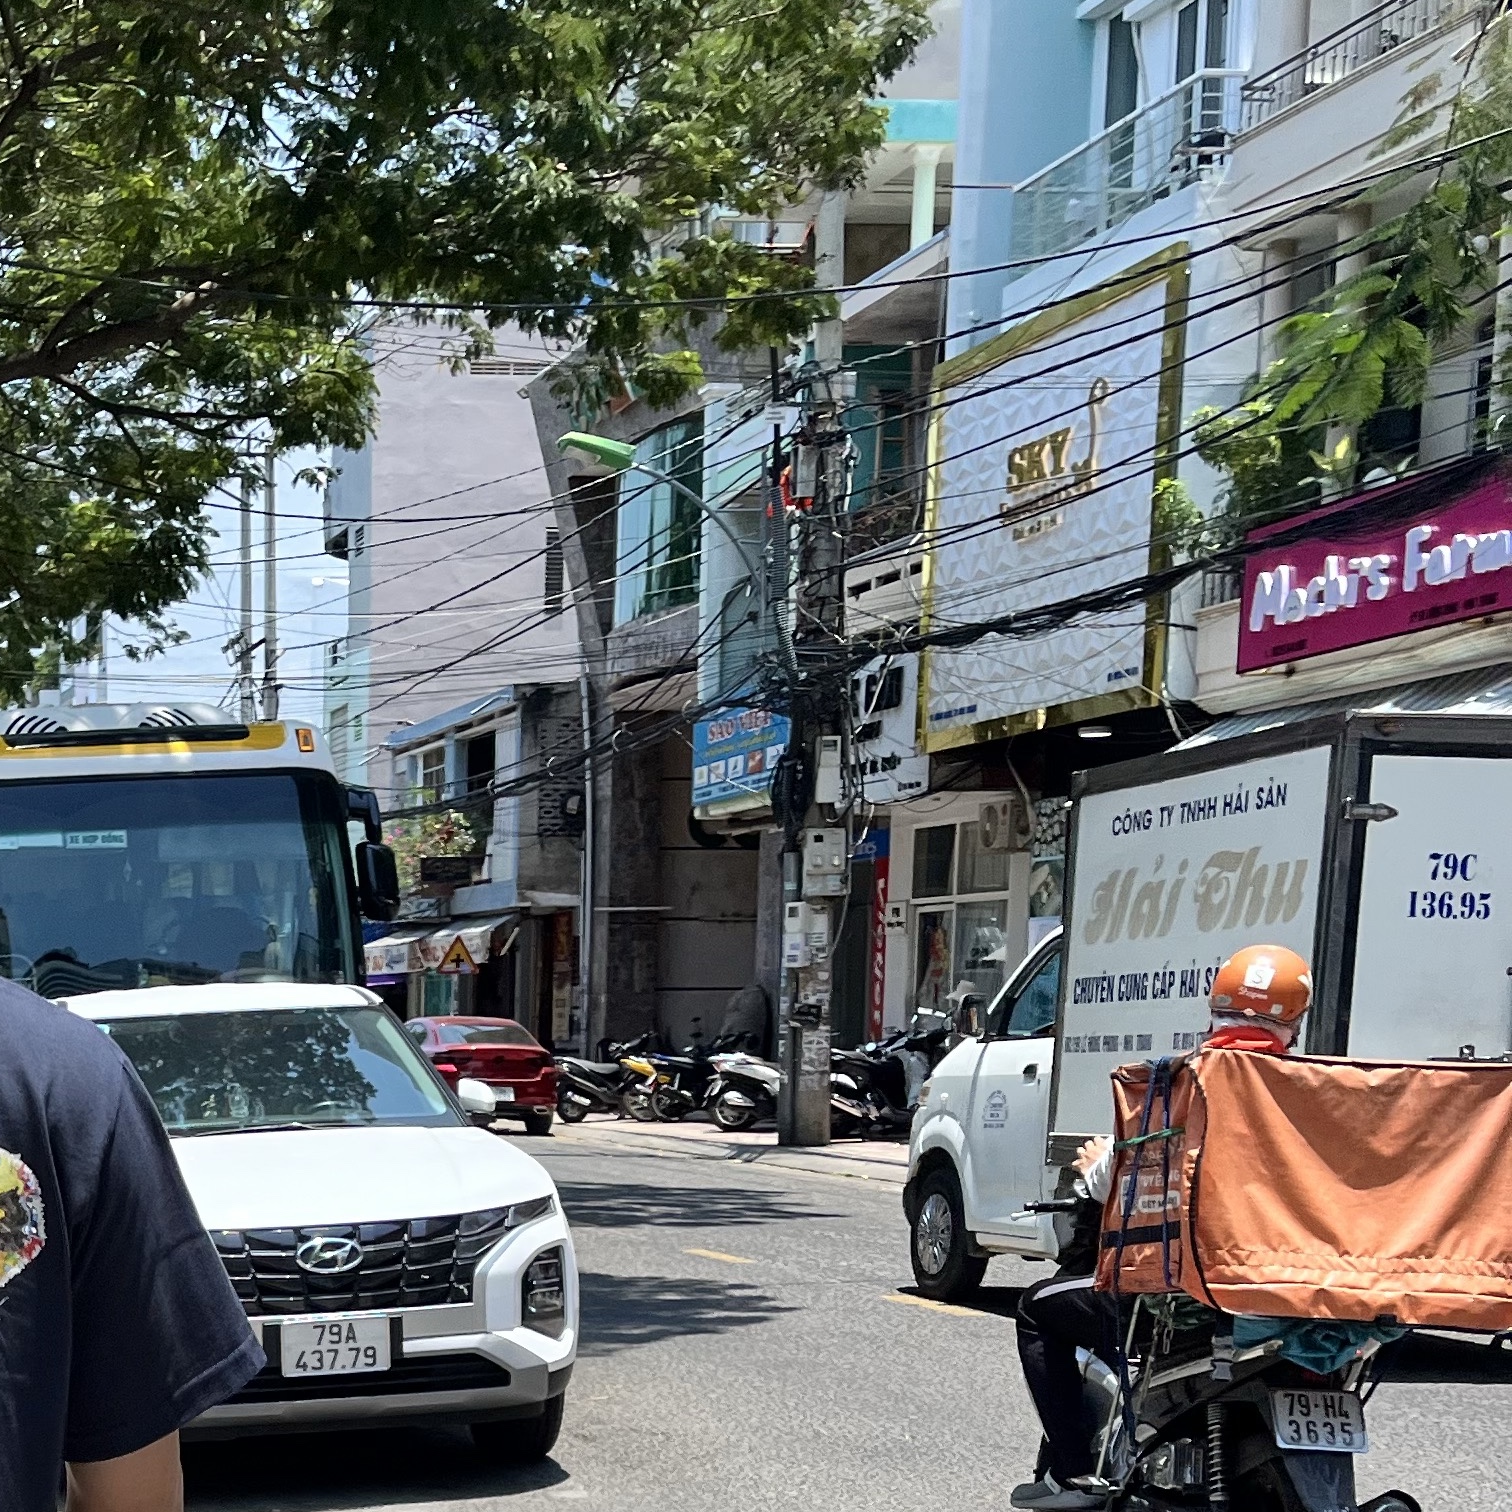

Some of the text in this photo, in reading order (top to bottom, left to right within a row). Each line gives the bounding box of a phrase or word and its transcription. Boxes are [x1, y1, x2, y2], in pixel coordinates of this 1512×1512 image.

[1006, 427, 1071, 494] SKY
[1112, 777, 1288, 836] CÔNG TY TNHH HẢI SẢN
[1429, 853, 1478, 881] 79C
[1193, 846, 1309, 932] Thu
[1407, 891, 1491, 919] 136.95
[1118, 972, 1148, 1001] CUNG
[313, 1323, 357, 1345] 79A
[295, 1346, 377, 1371] 437.79
[1289, 1420, 1354, 1446] 3635
